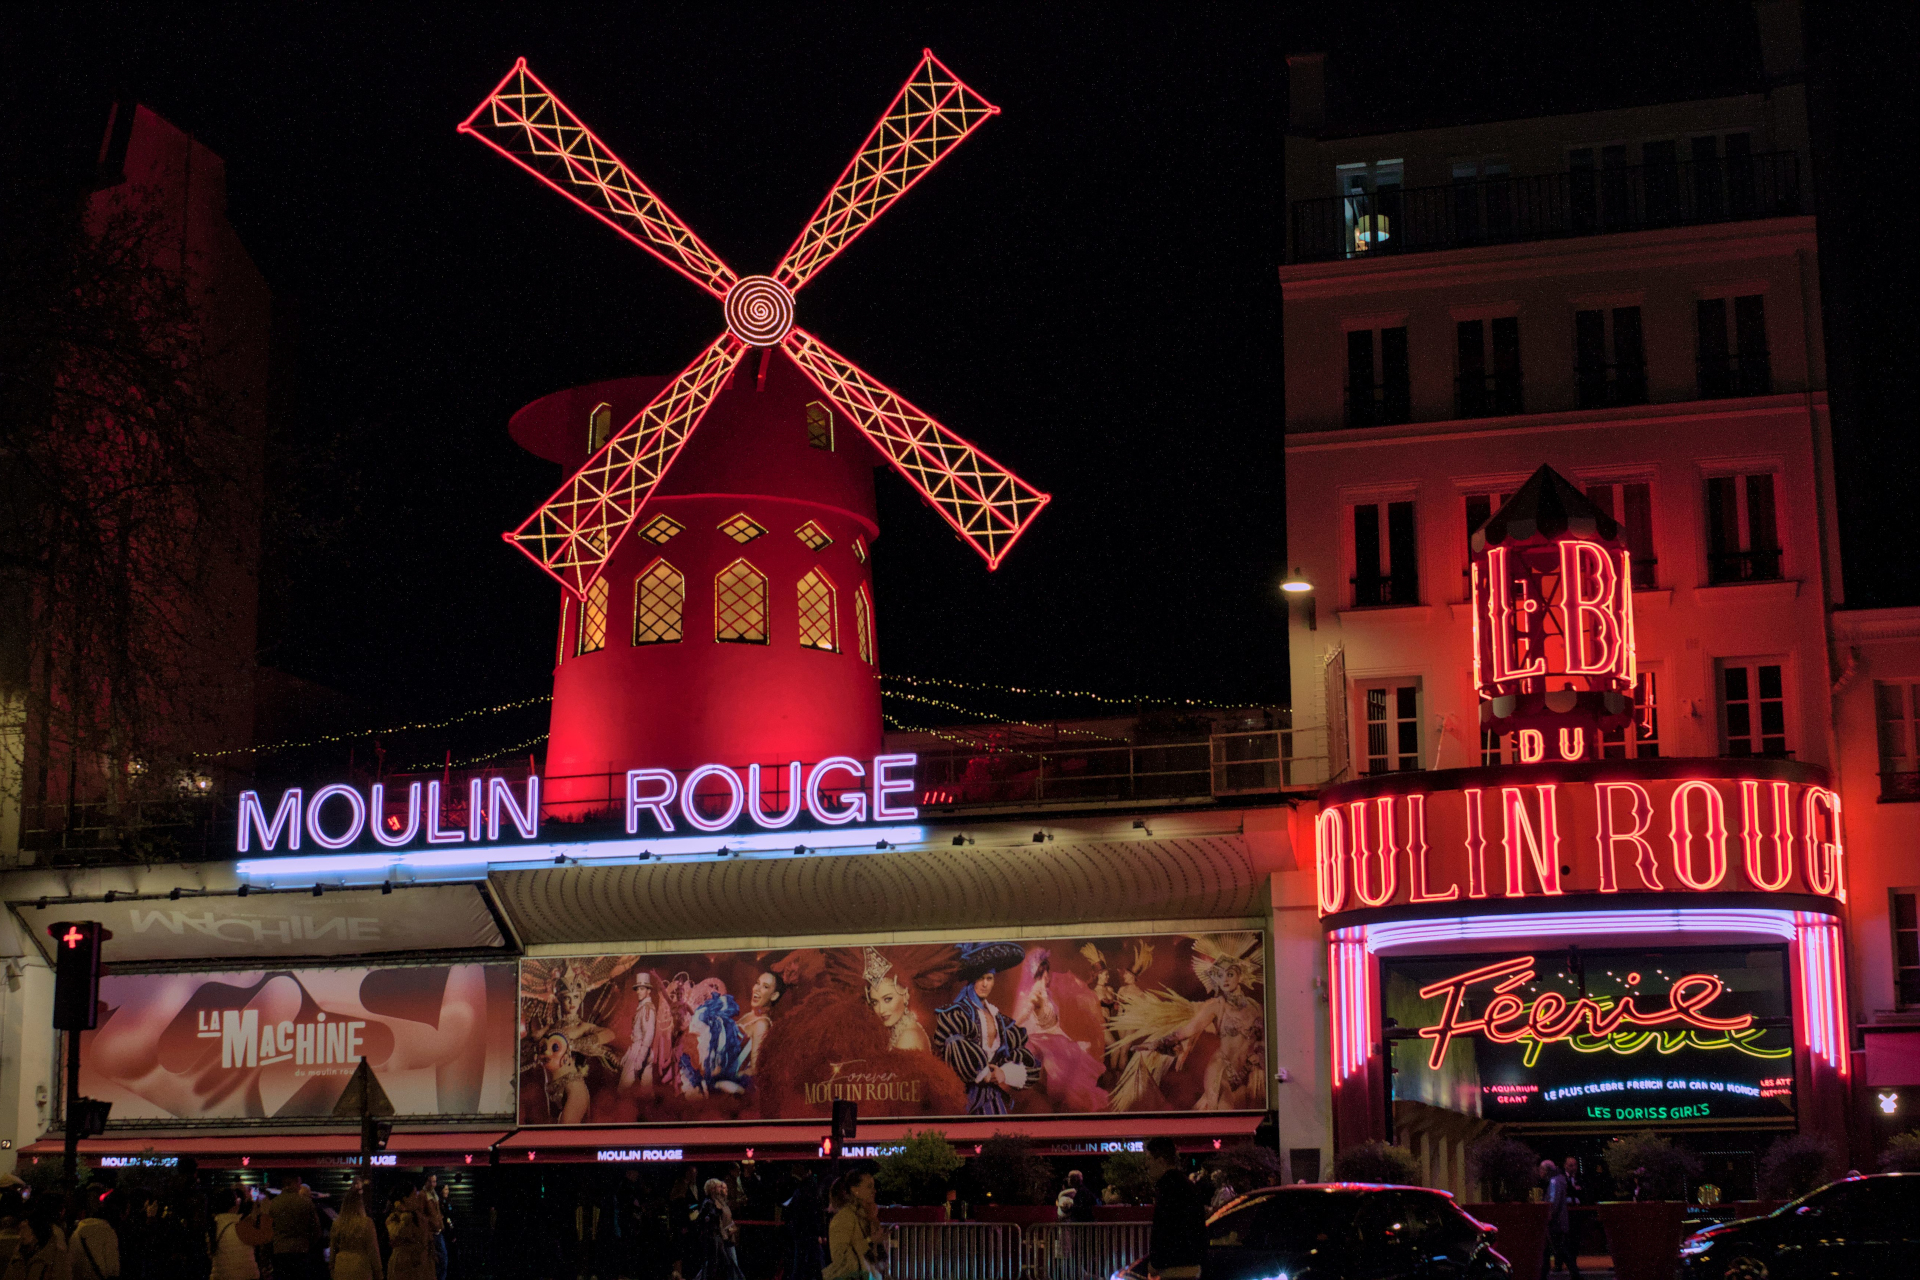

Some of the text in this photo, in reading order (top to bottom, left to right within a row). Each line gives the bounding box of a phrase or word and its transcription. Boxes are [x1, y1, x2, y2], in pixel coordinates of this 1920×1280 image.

[1519, 727, 1585, 763] DU
[237, 753, 918, 852] MOULIN ROUGE
[1315, 784, 1564, 918] OULIN
[198, 1010, 221, 1031] LA
[1418, 955, 1753, 1071] Féerie
[308, 1067, 337, 1077] moulin
[821, 1058, 899, 1085] Forever
[865, 1080, 920, 1102] ROUGE
[1544, 1090, 1557, 1102] LE
[1558, 1086, 1584, 1099] PLUS
[1583, 1081, 1624, 1094] CELEBRE
[1626, 1079, 1664, 1090] FRENCH
[1666, 1079, 1687, 1090] CAN
[1688, 1080, 1709, 1090] CAN
[1709, 1081, 1724, 1092] DU
[1726, 1083, 1760, 1097] MONDE
[1760, 1079, 1775, 1087] LES
[1496, 1095, 1528, 1104] GEANT
[1587, 1106, 1612, 1119] LES
[1615, 1107, 1668, 1120] DORISS
[597, 1149, 683, 1161] MOULIN ROUGE
[1051, 1142, 1098, 1153] MOULIN
[317, 1156, 358, 1165] MOULIN
